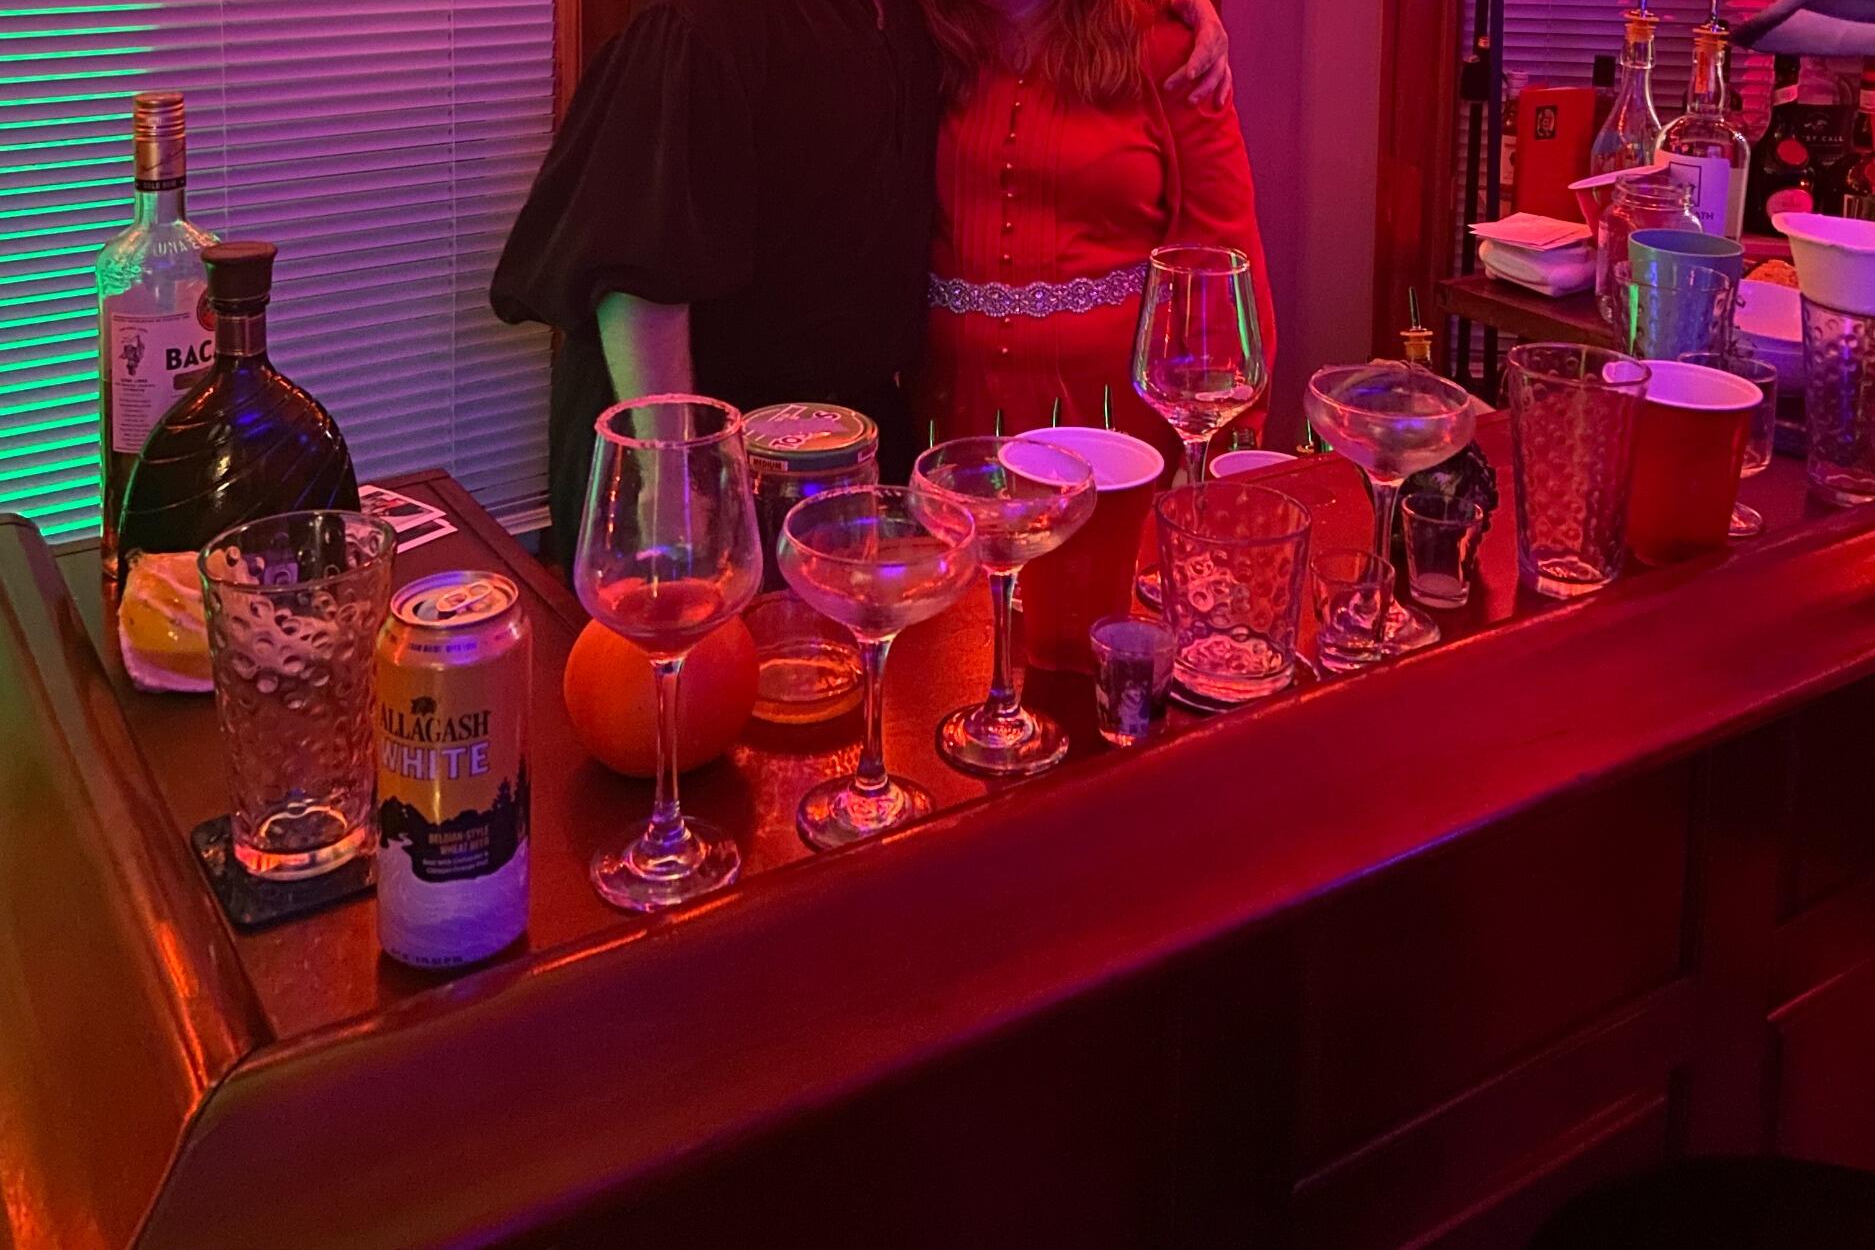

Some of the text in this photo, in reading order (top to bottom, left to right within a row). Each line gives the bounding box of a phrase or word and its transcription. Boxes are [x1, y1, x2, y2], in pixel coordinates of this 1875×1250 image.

[165, 339, 217, 371] BAC
[379, 702, 490, 743] ALLAGASH
[382, 736, 490, 781] WHITE
